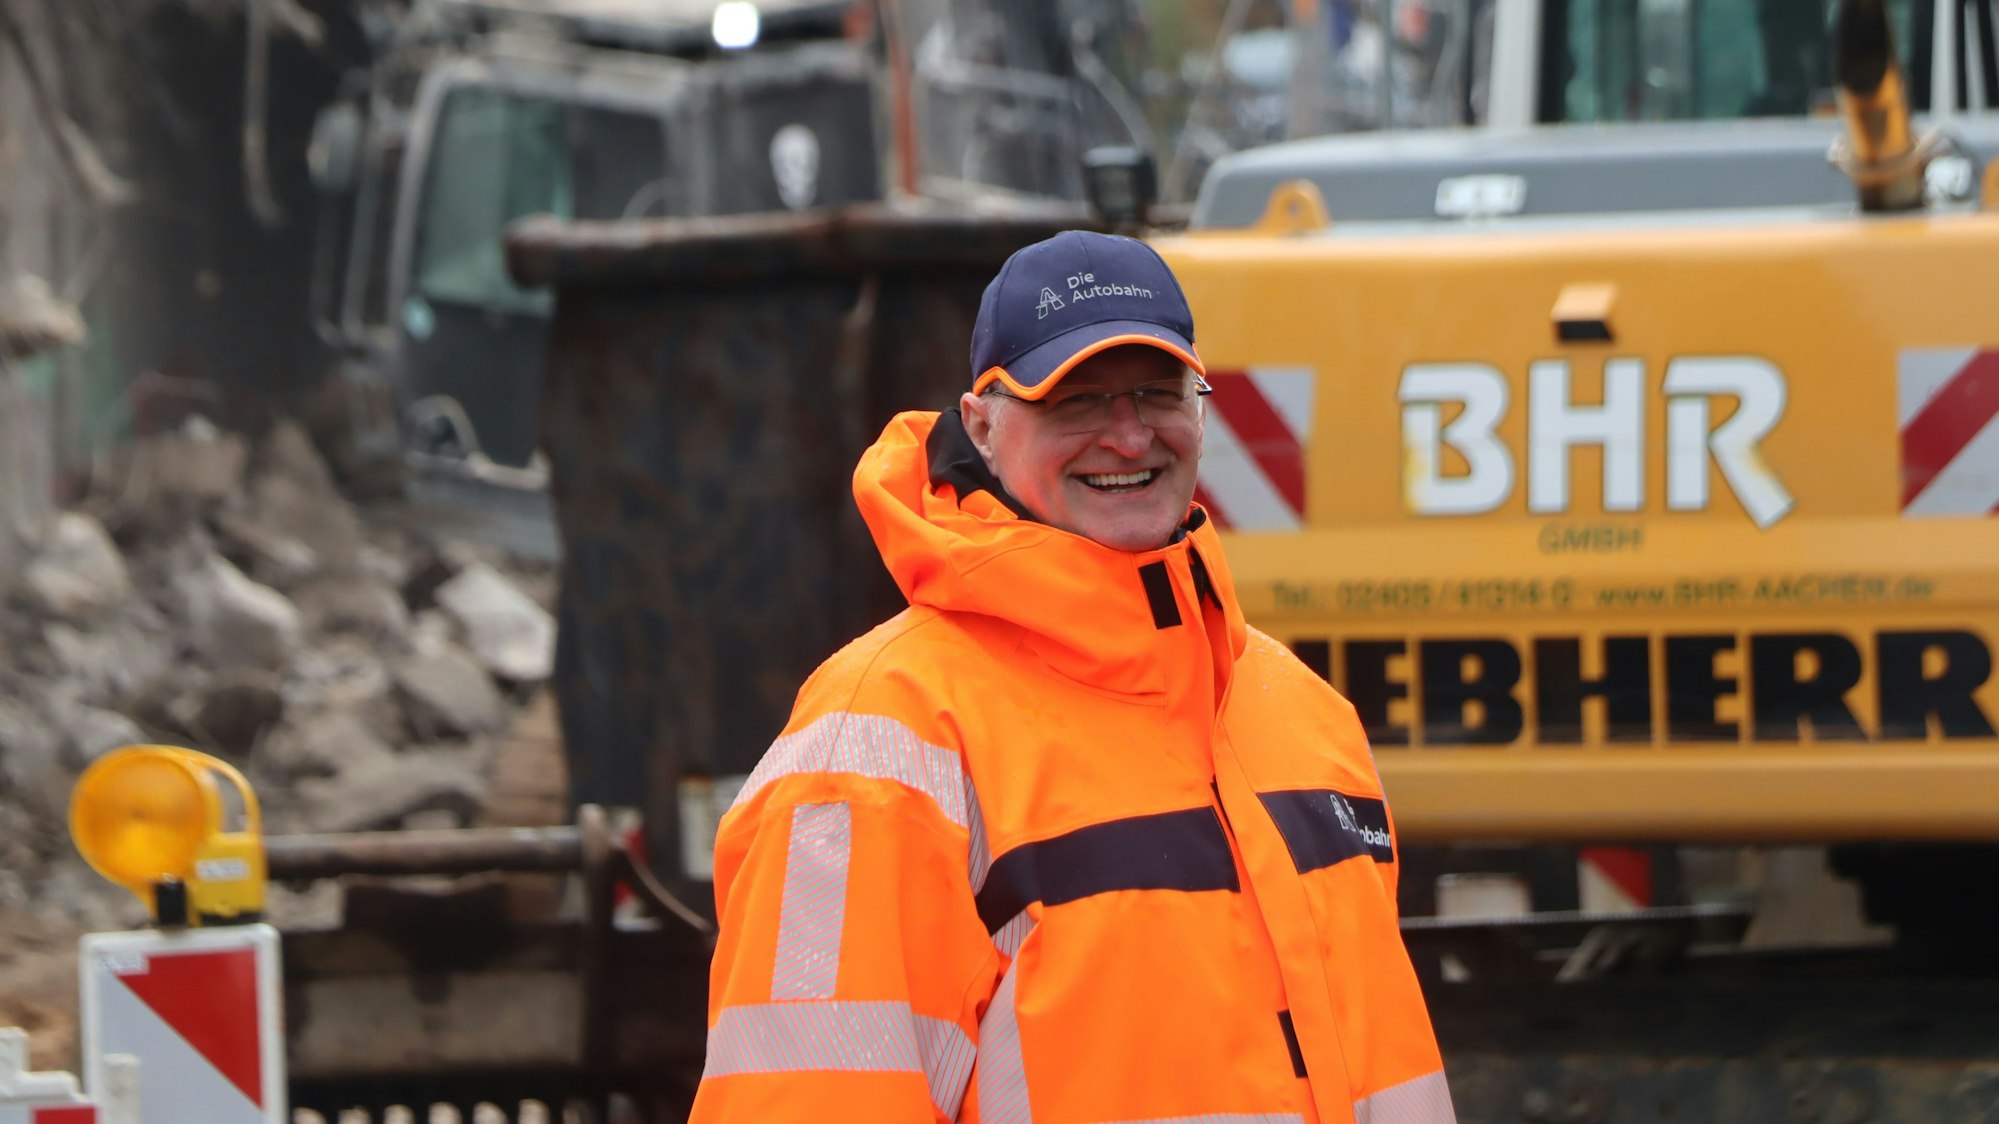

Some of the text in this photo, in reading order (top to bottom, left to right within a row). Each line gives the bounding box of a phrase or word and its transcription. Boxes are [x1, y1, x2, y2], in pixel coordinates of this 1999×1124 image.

[1067, 272, 1094, 289] Die
[1072, 283, 1152, 303] Autobahn
[1398, 355, 1796, 530] BHR
[1538, 522, 1644, 555] GMBH
[1292, 631, 1998, 744] EBHERR
